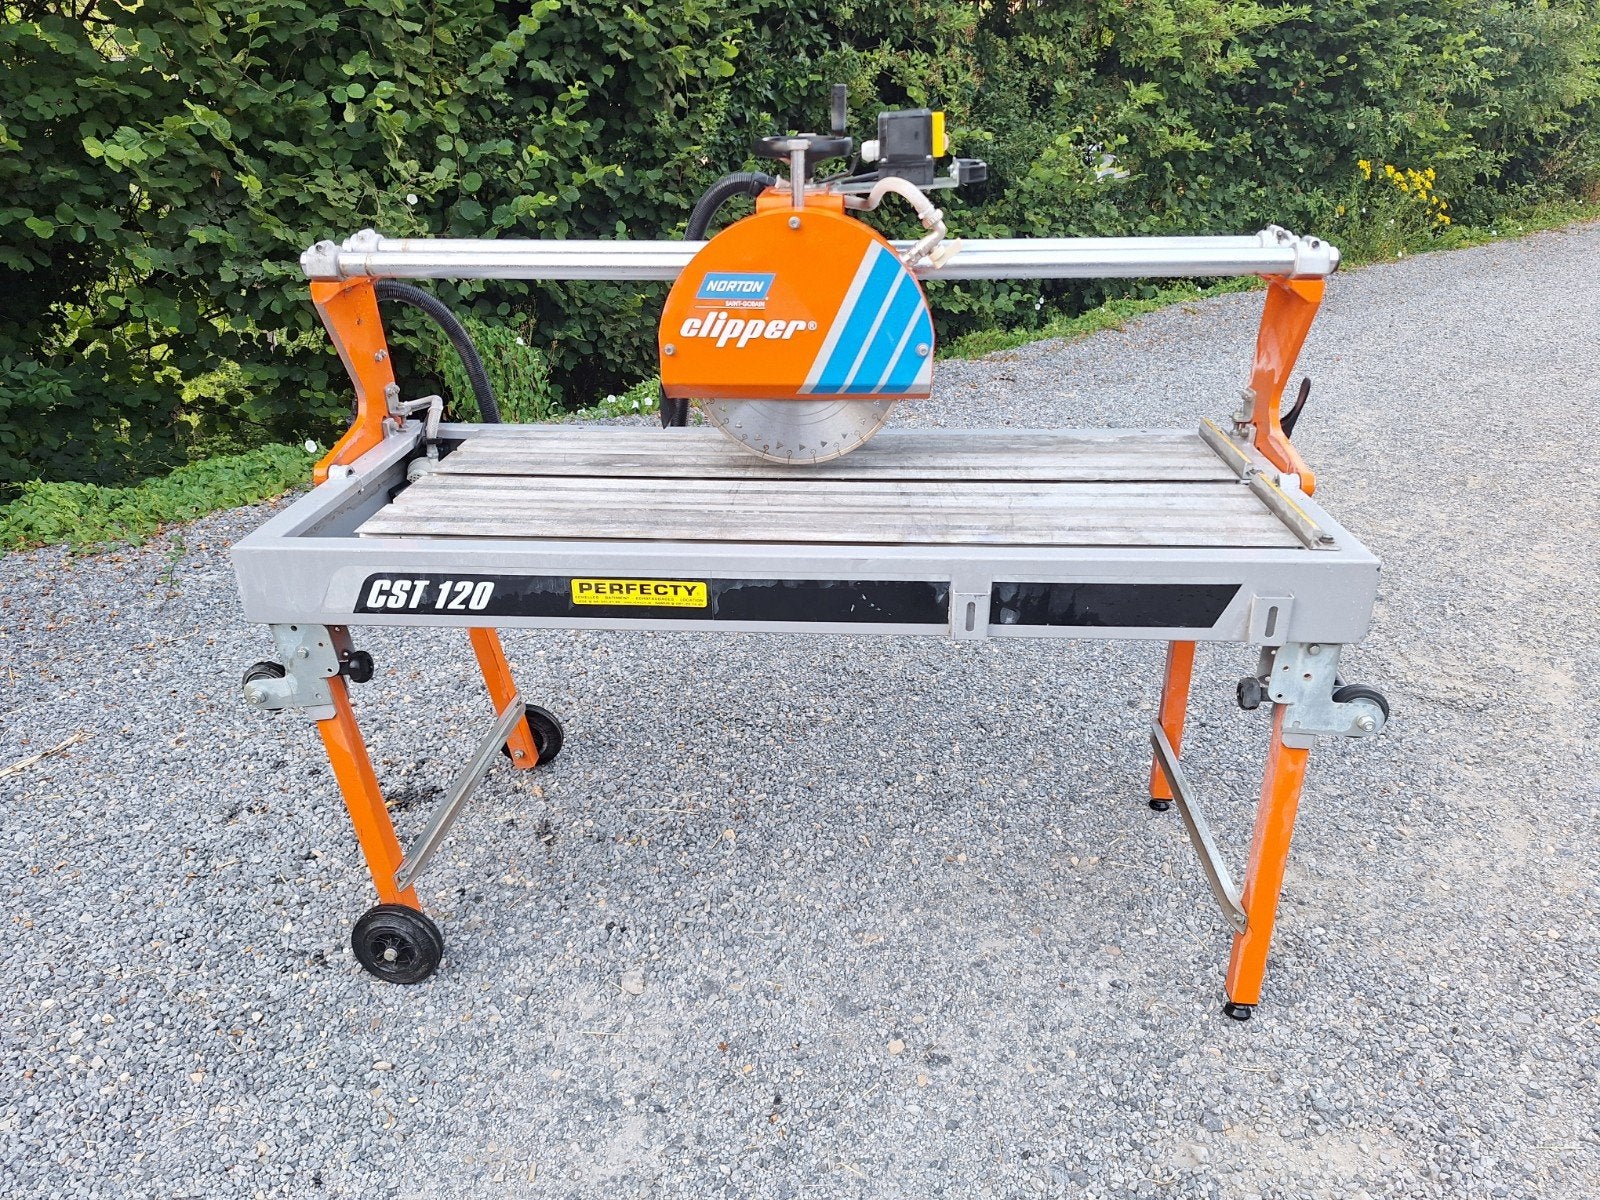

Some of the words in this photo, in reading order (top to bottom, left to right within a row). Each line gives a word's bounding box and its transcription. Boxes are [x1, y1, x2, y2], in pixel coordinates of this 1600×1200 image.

[706, 280, 764, 292] NORTON
[366, 579, 430, 609] CST
[434, 580, 495, 610] 120
[578, 583, 697, 596] PERFECTY
